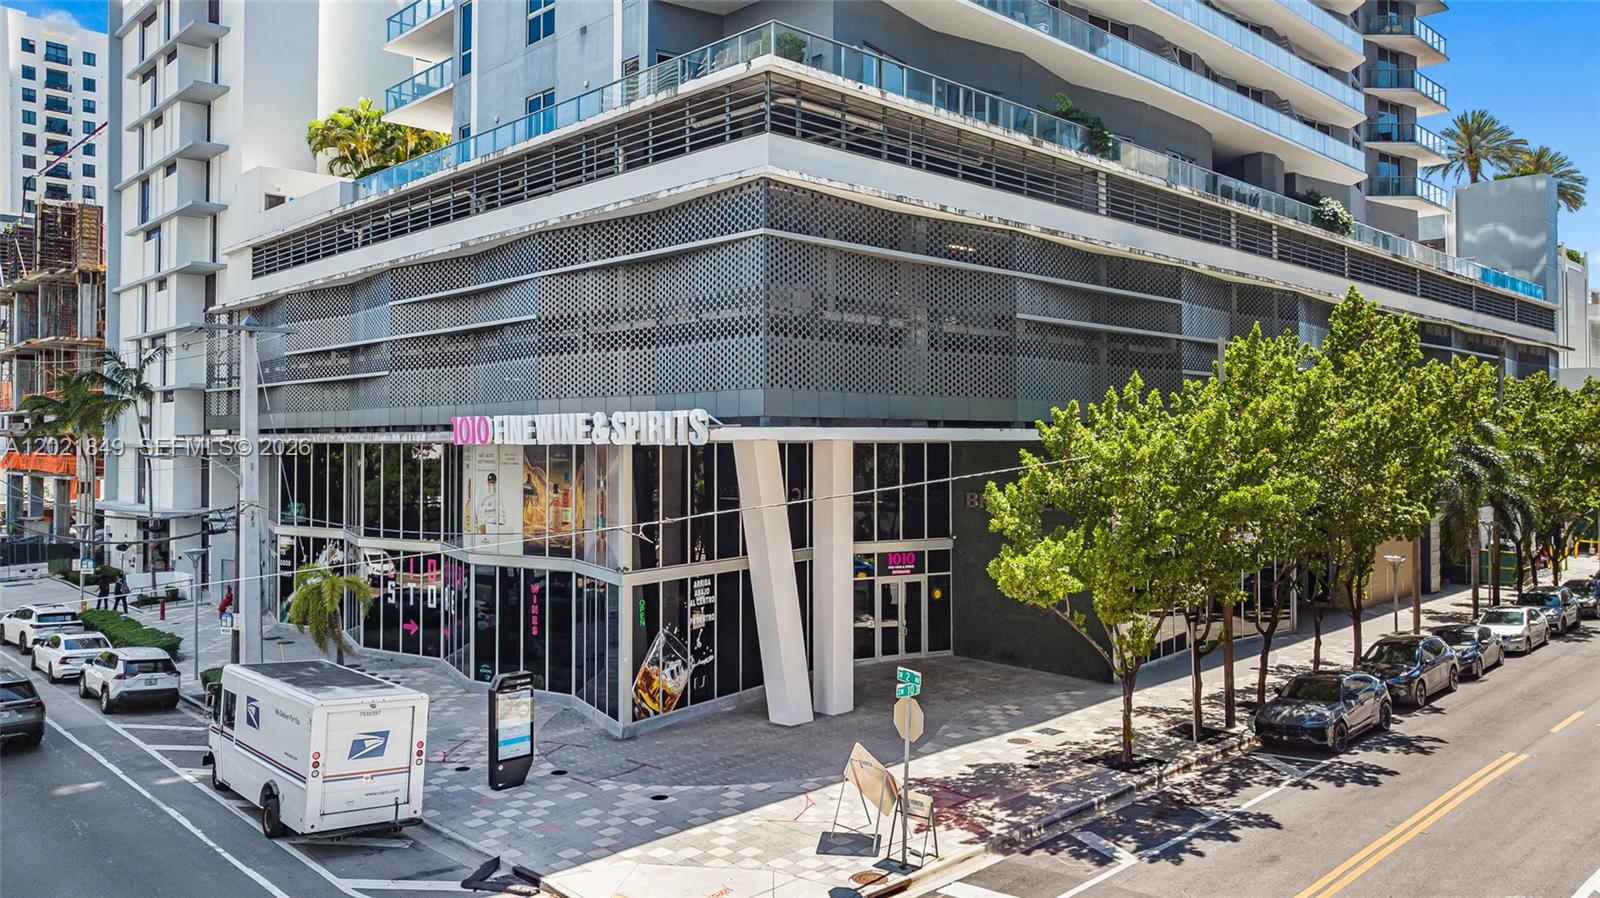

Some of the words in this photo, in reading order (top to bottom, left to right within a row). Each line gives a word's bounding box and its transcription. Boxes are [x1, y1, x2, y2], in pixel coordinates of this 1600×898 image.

[451, 415, 492, 446] 1010
[493, 414, 536, 446] FINE
[536, 412, 592, 446] WINE
[592, 411, 611, 446] &
[610, 408, 709, 447] SPIRITS
[888, 552, 917, 565] 1010
[693, 579, 711, 588] ARRIBA
[694, 587, 710, 597] ABAJO
[696, 596, 715, 606] CENTRO
[530, 583, 540, 636] WINES
[905, 672, 911, 681] 2
[907, 685, 915, 696] 10
